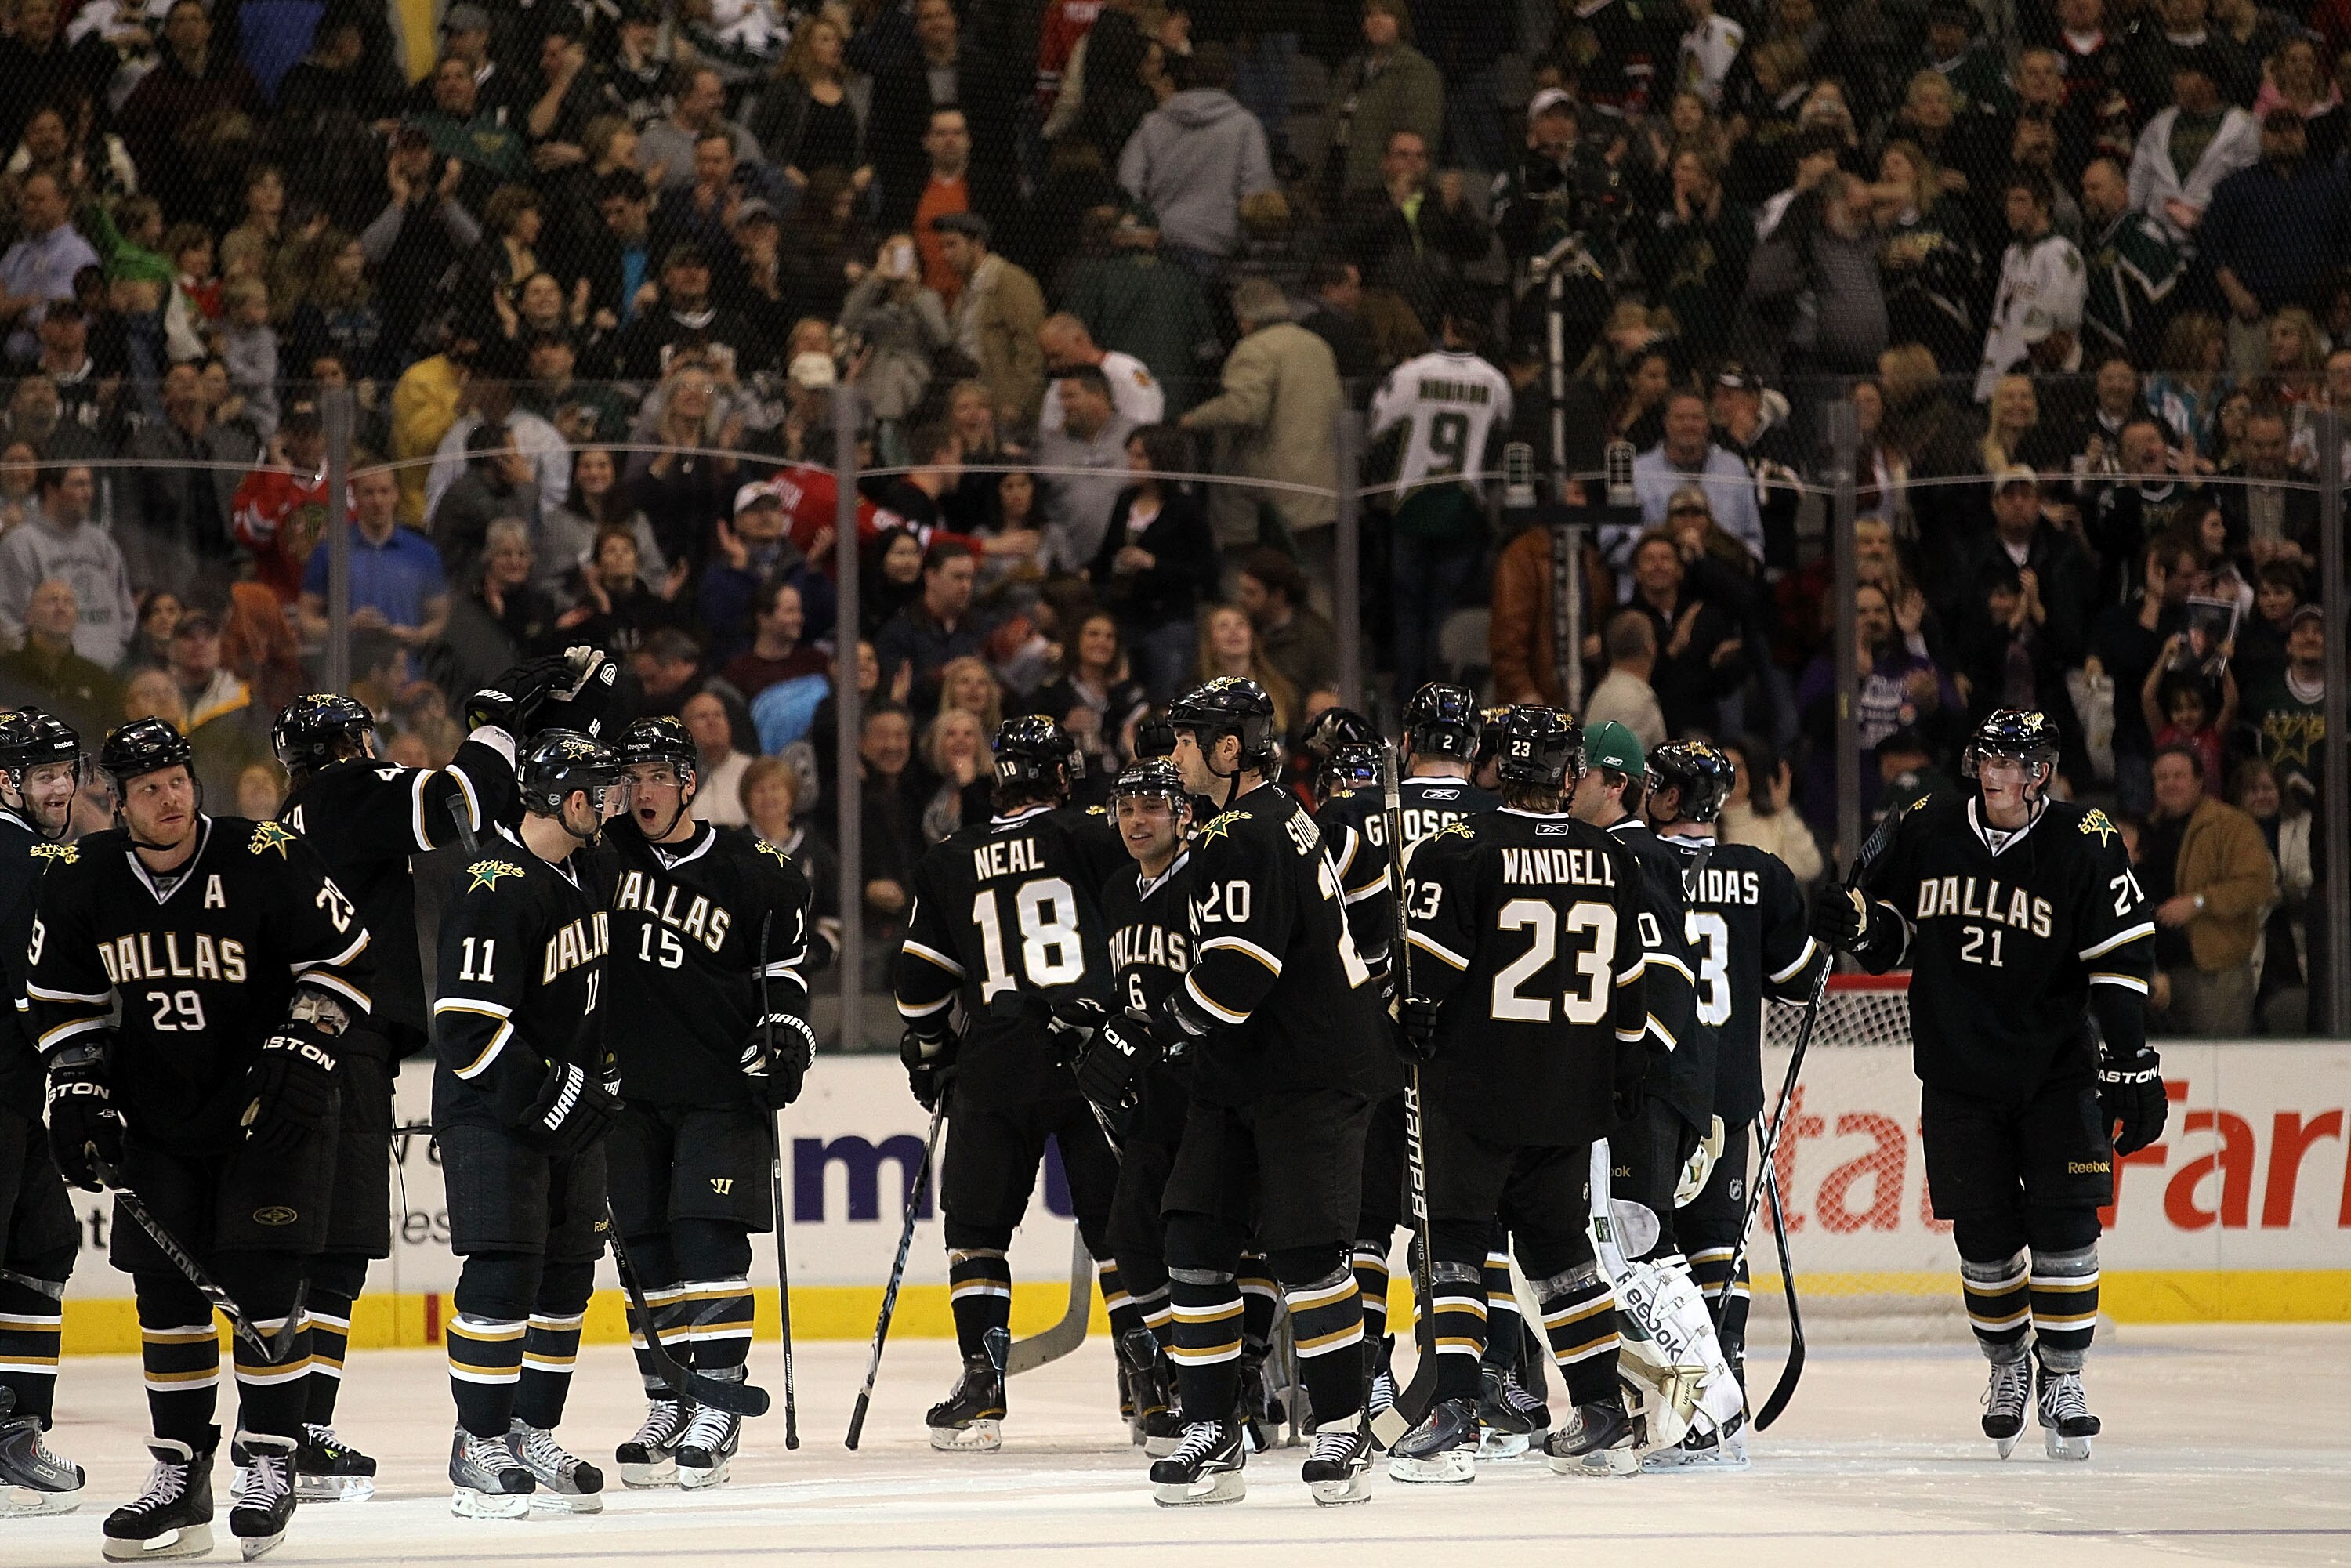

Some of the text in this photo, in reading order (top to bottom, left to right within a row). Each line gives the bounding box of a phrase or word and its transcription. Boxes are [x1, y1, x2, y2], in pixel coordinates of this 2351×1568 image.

[1430, 411, 1469, 476] 9
[53, 741, 74, 750] Reebok
[561, 739, 596, 752] STARS
[627, 742, 650, 751] Reebok
[1442, 734, 1453, 750] 2
[1512, 741, 1531, 758] 23
[1002, 760, 1016, 777] 18
[1200, 809, 1253, 832] STARS
[466, 860, 526, 878] STARS
[973, 838, 1045, 882] NEAL
[1501, 848, 1615, 889] WANDELL
[205, 875, 226, 909] A
[315, 876, 355, 935] 29
[1197, 879, 1252, 923] 20
[1682, 867, 1759, 905] IDAS
[2110, 867, 2144, 918] 21
[612, 869, 732, 953] ALLAS
[1916, 875, 2053, 939] DALLAS
[27, 918, 47, 967] 9
[639, 922, 684, 969] 15
[972, 877, 1086, 1005] 18
[1637, 911, 1663, 947] 0
[1961, 925, 2005, 968] 21
[97, 932, 247, 984] DALLAS
[458, 936, 495, 983] 11
[1490, 897, 1617, 1025] 23
[147, 990, 206, 1031] 29
[585, 969, 600, 1016] 11
[1128, 973, 1147, 1010] 6
[263, 1036, 336, 1072] STON
[48, 1082, 110, 1104] STON
[2097, 1065, 2158, 1085] ASTON
[2068, 1161, 2110, 1174] Reebok
